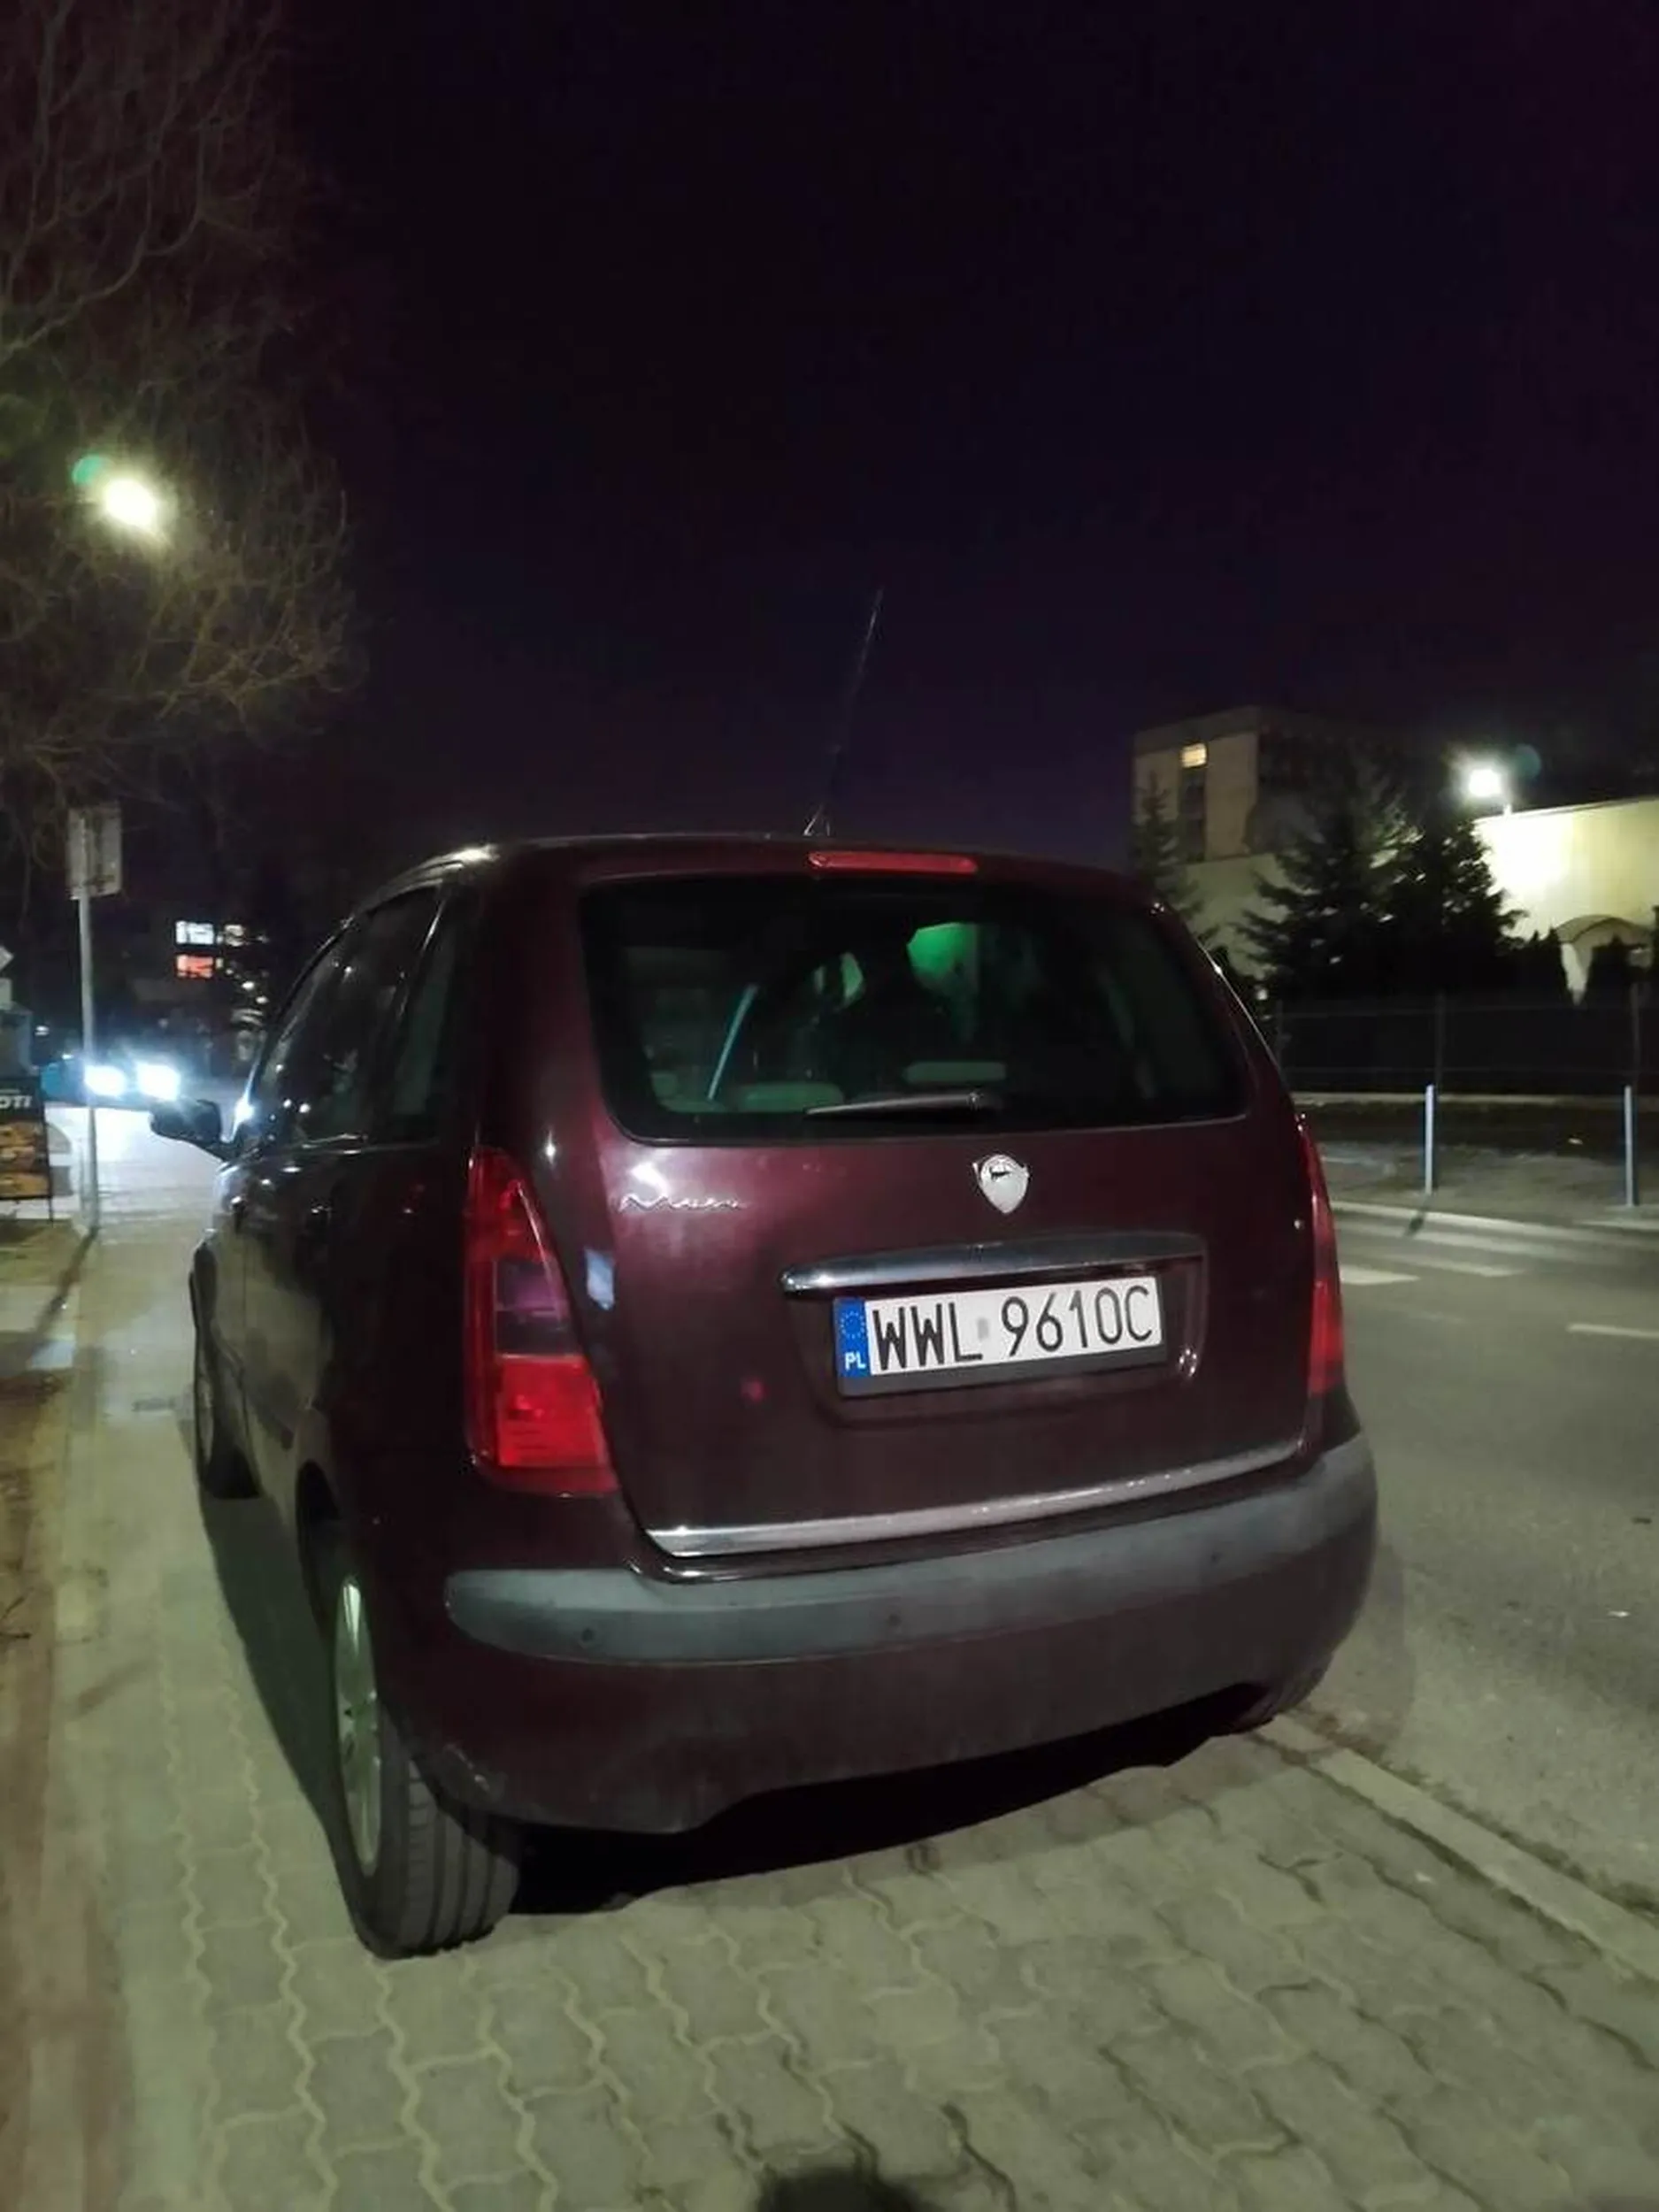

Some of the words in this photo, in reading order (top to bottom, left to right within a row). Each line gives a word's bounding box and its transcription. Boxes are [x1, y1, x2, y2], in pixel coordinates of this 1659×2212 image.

[872, 1302, 983, 1371] WWL
[1001, 1285, 1152, 1356] 9610C
[845, 1351, 866, 1371] PL
